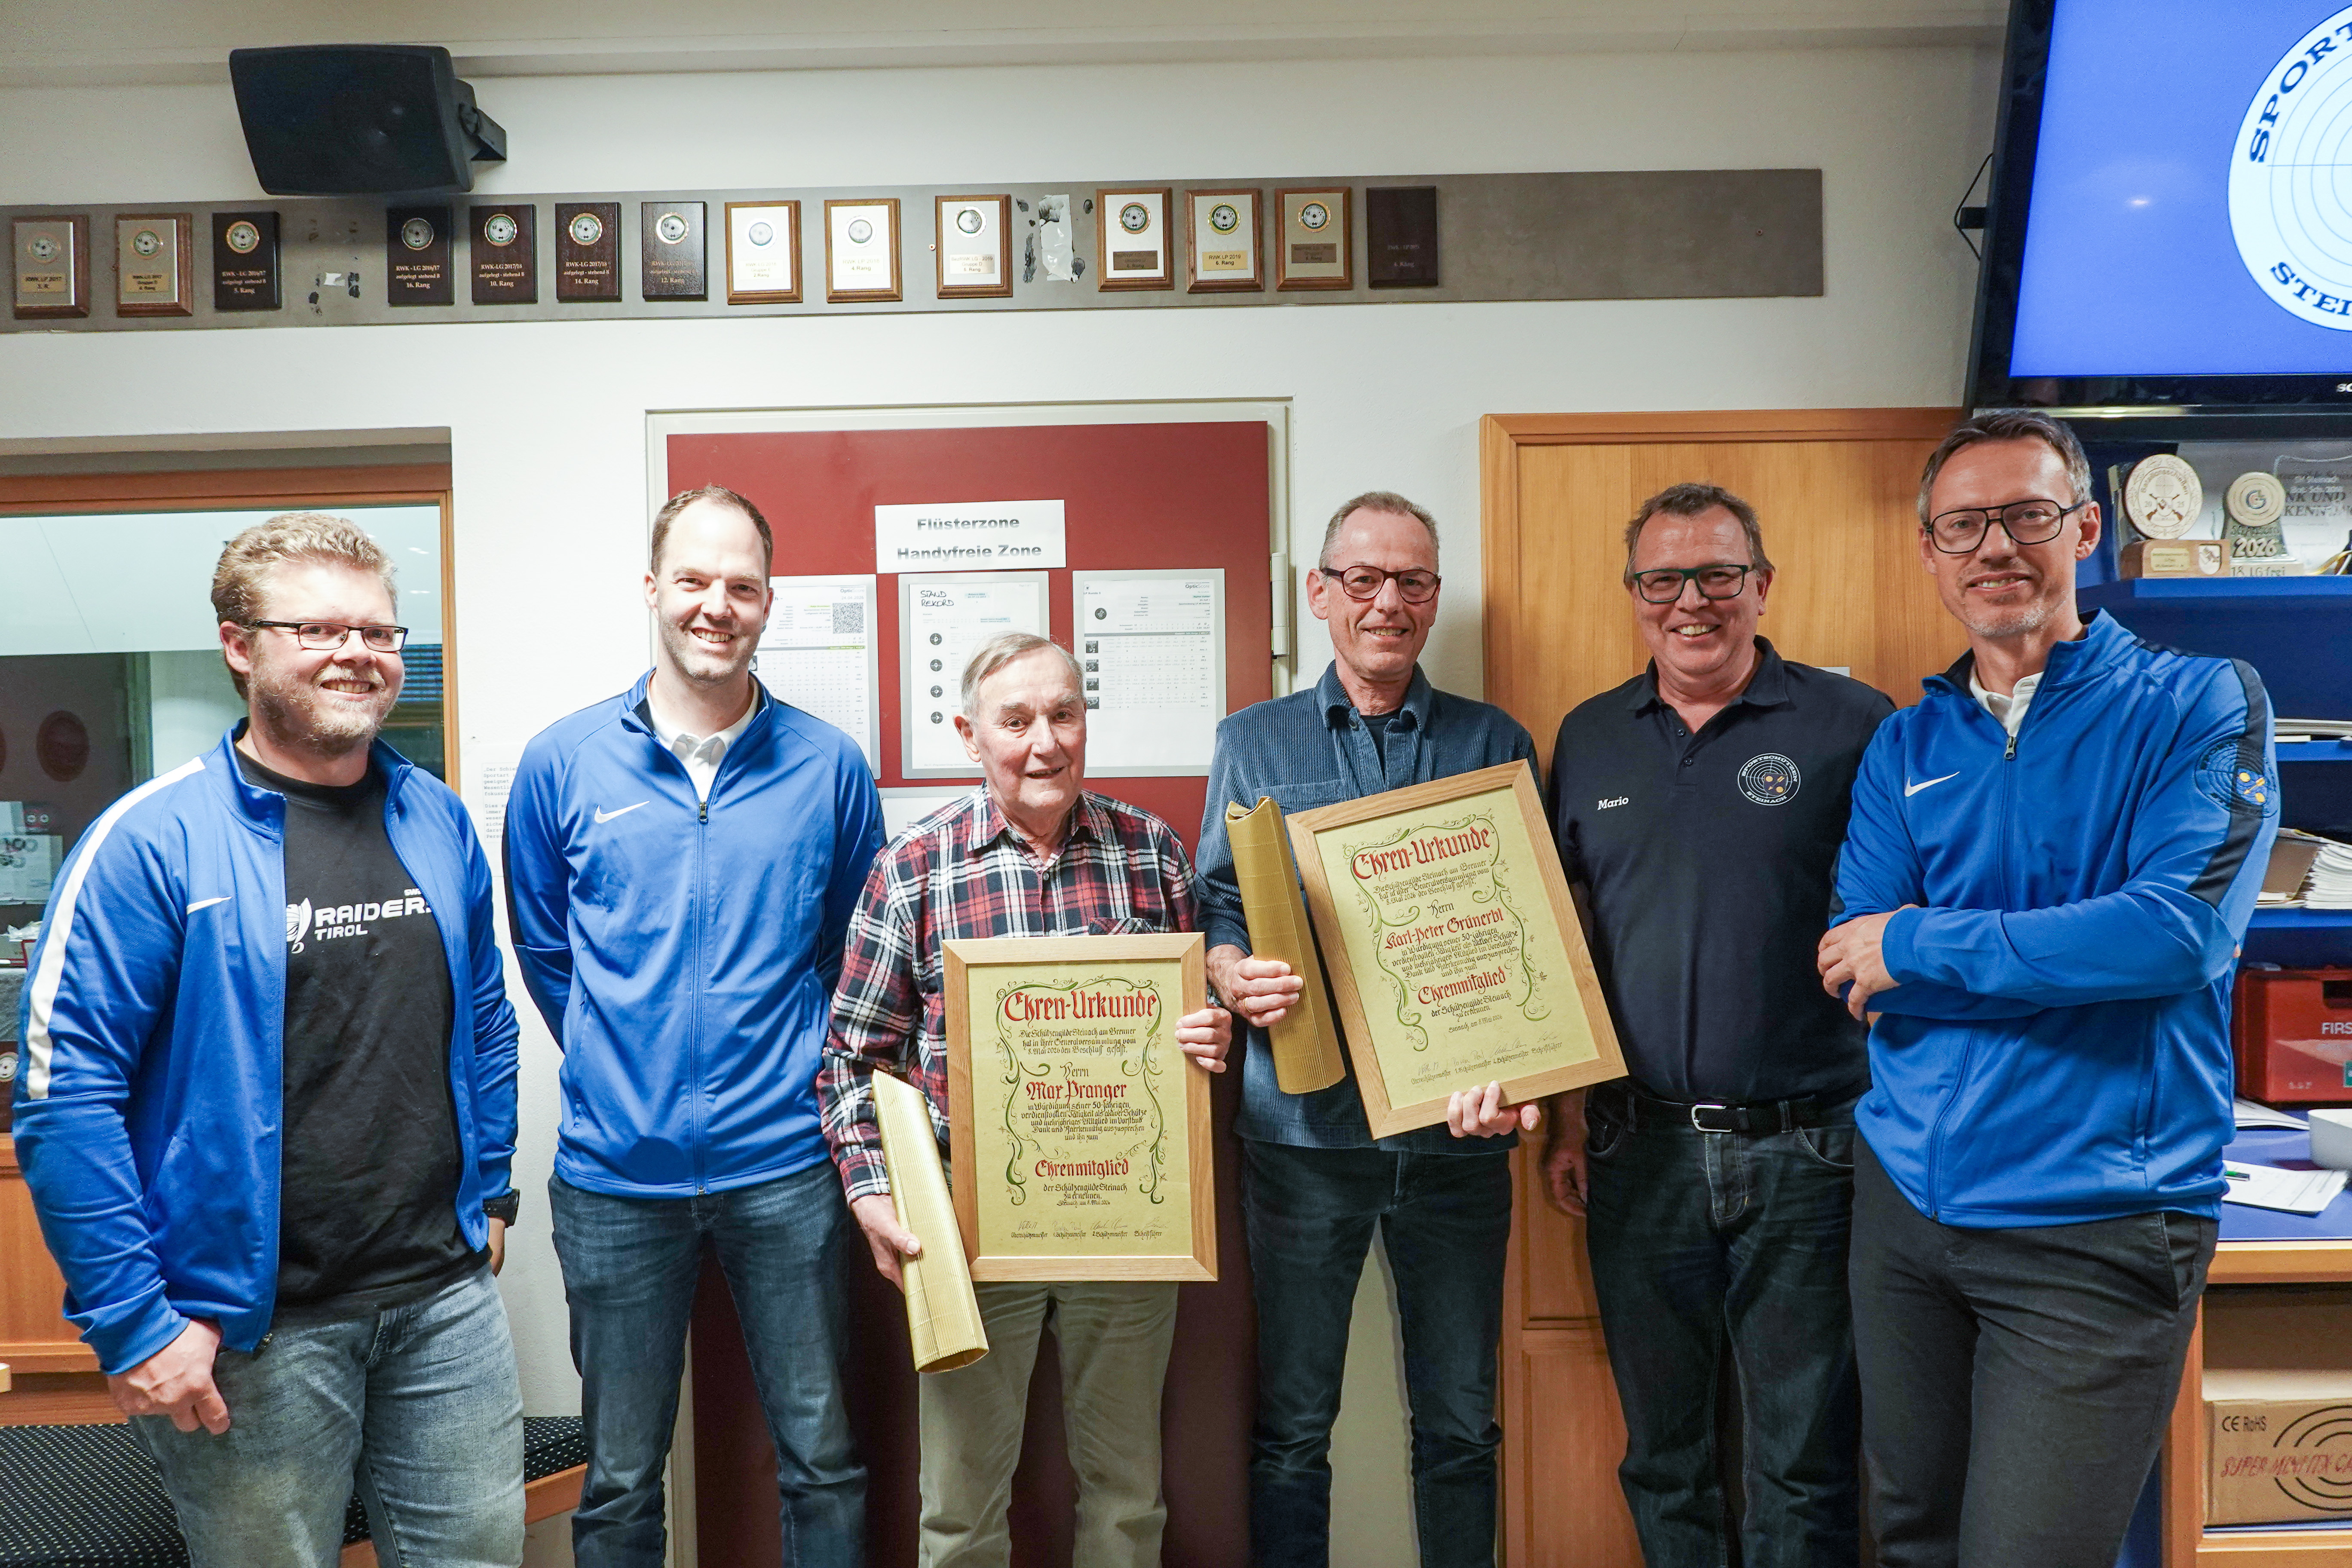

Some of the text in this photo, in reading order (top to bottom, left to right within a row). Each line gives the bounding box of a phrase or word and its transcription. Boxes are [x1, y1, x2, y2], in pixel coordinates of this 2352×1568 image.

[917, 518, 1020, 531] Flüsterzone
[897, 545, 1041, 562] Handyfreie Zone
[2233, 538, 2279, 557] 2026
[922, 598, 954, 607] REKORD
[1597, 796, 1629, 811] Mario
[1746, 791, 1787, 803] STEINACH
[1352, 826, 1491, 882] Ehren-Urkunde
[1373, 885, 1385, 894] Die
[1384, 876, 1421, 892] Schützengilde
[1422, 868, 1448, 881] Steinach
[1460, 860, 1487, 871] Brenner
[1379, 891, 1389, 901] hat
[1414, 871, 1477, 891] Generalversammlung
[1404, 891, 1416, 900] 2026
[314, 896, 432, 928] RAIDER
[1427, 899, 1454, 919] Herrn
[314, 924, 368, 941] TIROL
[1384, 908, 1504, 949] Karl-Peter Grünerbl
[1494, 930, 1518, 941] Schütze
[1409, 940, 1442, 955] Würdigung
[1443, 936, 1461, 946] seiner
[1454, 948, 1478, 960] Mitglied
[1488, 940, 1513, 950] Vorstand
[1405, 970, 1423, 978] Dank
[1424, 965, 1435, 974] und
[1441, 965, 1478, 977] und ihn zum
[1418, 966, 1506, 1007] Ehrenmitglied
[1004, 990, 1157, 1028] Ehren-Urkunde
[1441, 998, 1483, 1016] Schützengilde
[1483, 989, 1512, 1003] Steinach
[1455, 1011, 1463, 1023] zu
[1031, 1029, 1072, 1040] Schützengilde
[1072, 1028, 1098, 1039] Steinach
[1023, 1039, 1032, 1050] hat
[1054, 1038, 1121, 1047] Generalversammlung
[1060, 1062, 1089, 1081] Herrn
[1026, 1080, 1127, 1106] Max Pranger
[1034, 1102, 1070, 1112] Würdigung
[1123, 1109, 1147, 1119] Schütze
[1077, 1133, 1085, 1144] ihn
[1086, 1134, 1098, 1143] zum
[1035, 1158, 1129, 1181] Ehrenmitglied
[1044, 1182, 1127, 1194] der Schützengilde Steinach
[2222, 1416, 2240, 1432] CE
